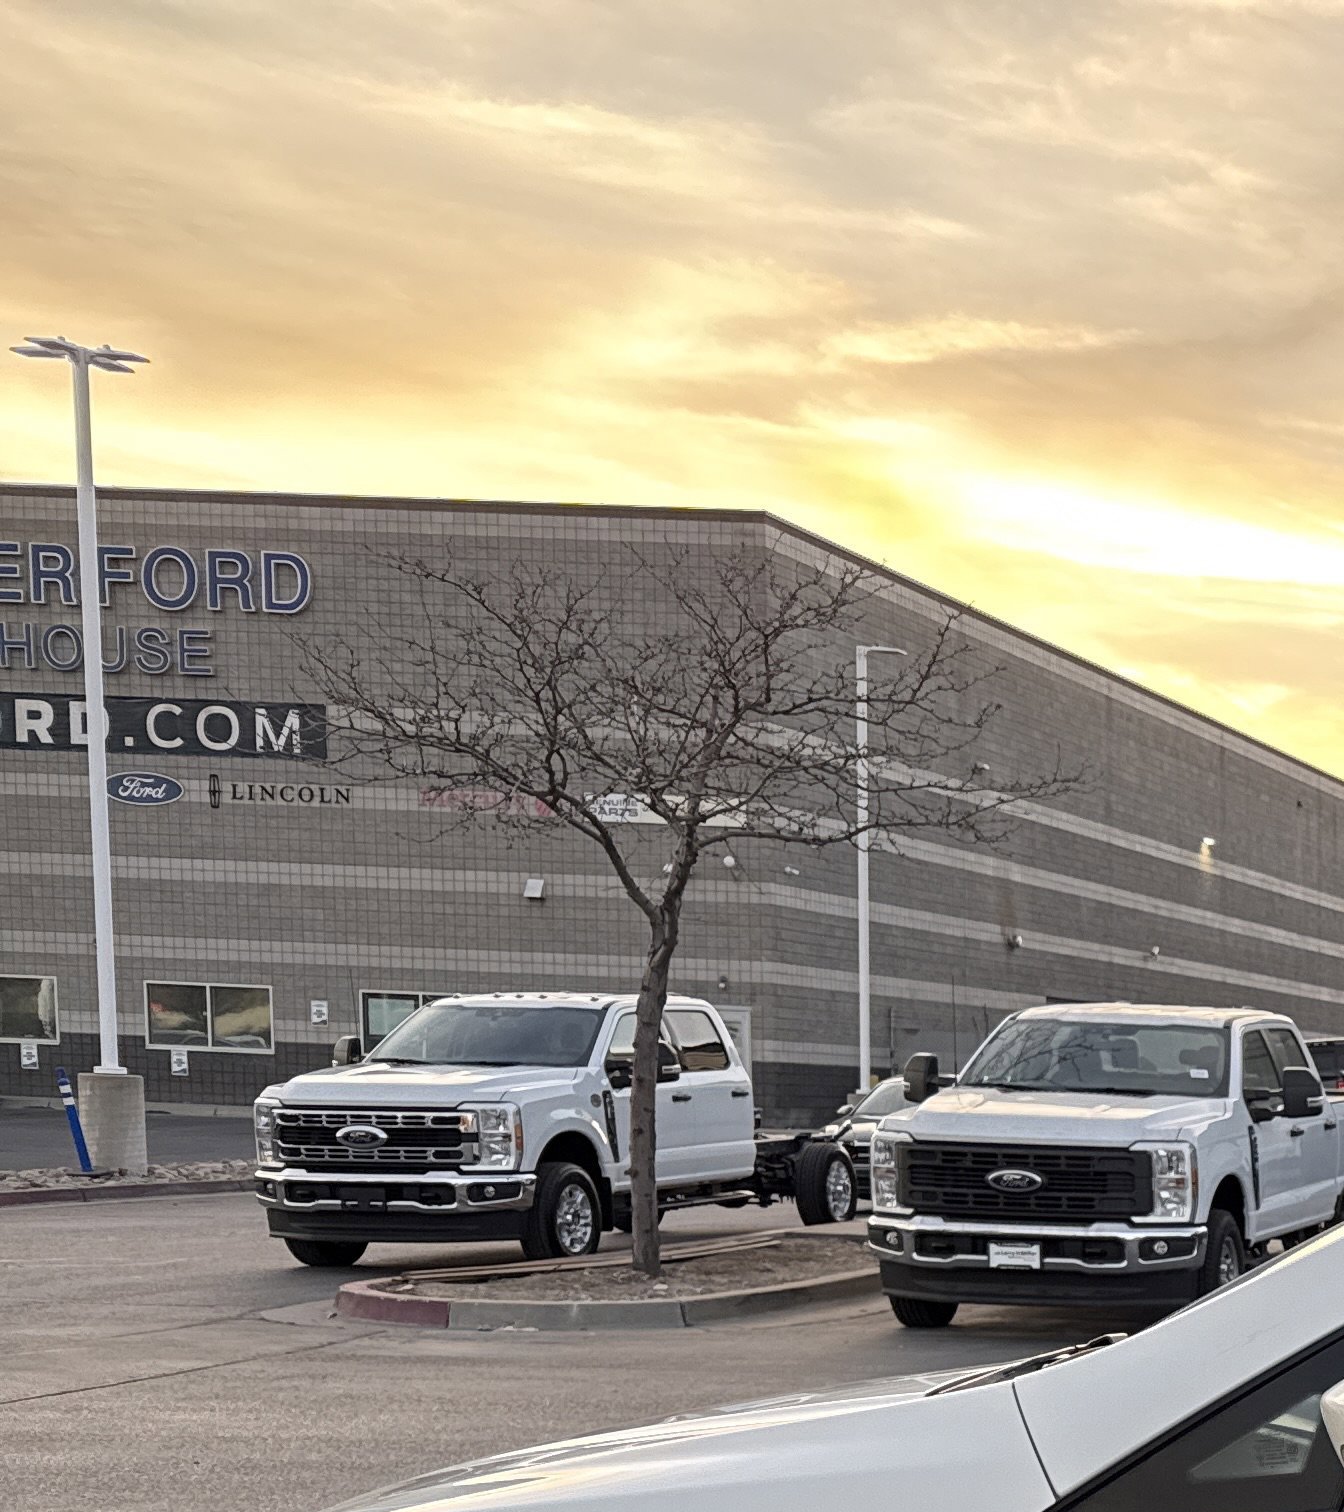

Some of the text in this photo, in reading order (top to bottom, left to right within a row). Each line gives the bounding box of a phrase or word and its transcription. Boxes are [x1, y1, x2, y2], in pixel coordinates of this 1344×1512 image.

[97, 545, 313, 615] FORD
[0, 621, 214, 676] HOUSE
[118, 776, 167, 799] Ford
[231, 783, 351, 805] LINCOLN
